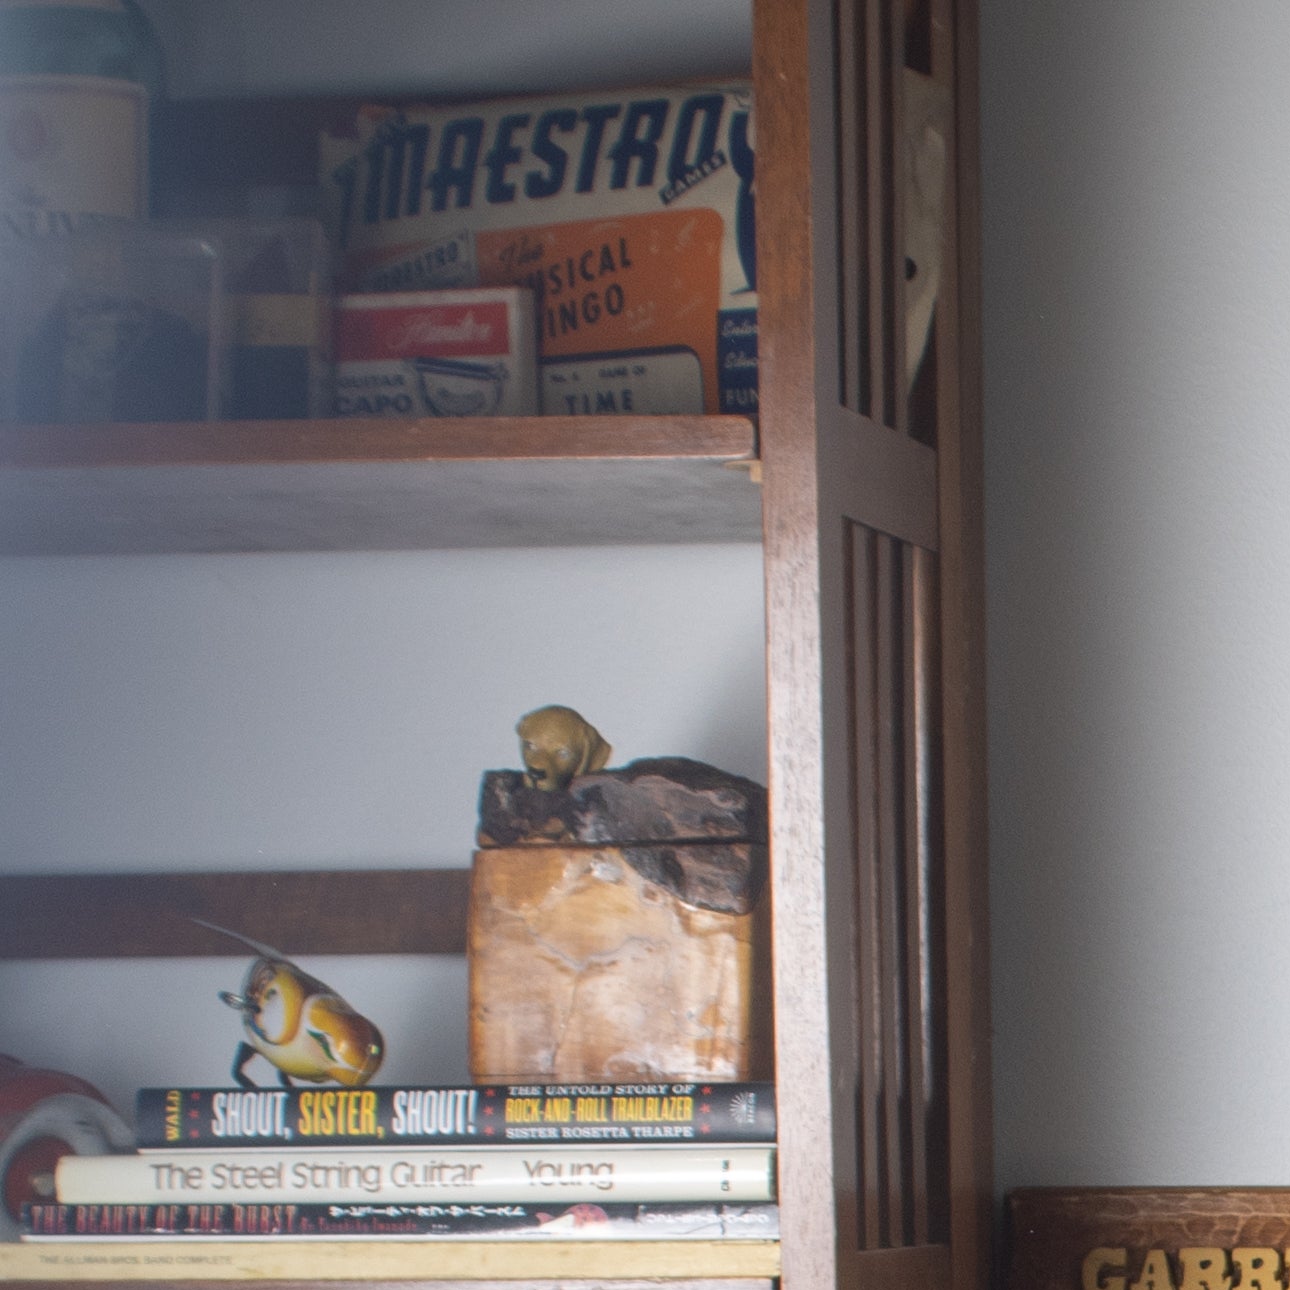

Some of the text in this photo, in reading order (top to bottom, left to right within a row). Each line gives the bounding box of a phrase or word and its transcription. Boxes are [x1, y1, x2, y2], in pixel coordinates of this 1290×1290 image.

[362, 93, 726, 225] MAESTRO
[165, 1090, 182, 1142] WALD
[211, 1090, 477, 1141] SHOUT, SISTER, SHOUT!
[505, 1096, 693, 1123] ROCK-AND-ROLL TRAILBLAZER
[505, 1126, 694, 1139] SISTER ROSETTA THARPE
[152, 1159, 614, 1193] The Steel String Guitar Young
